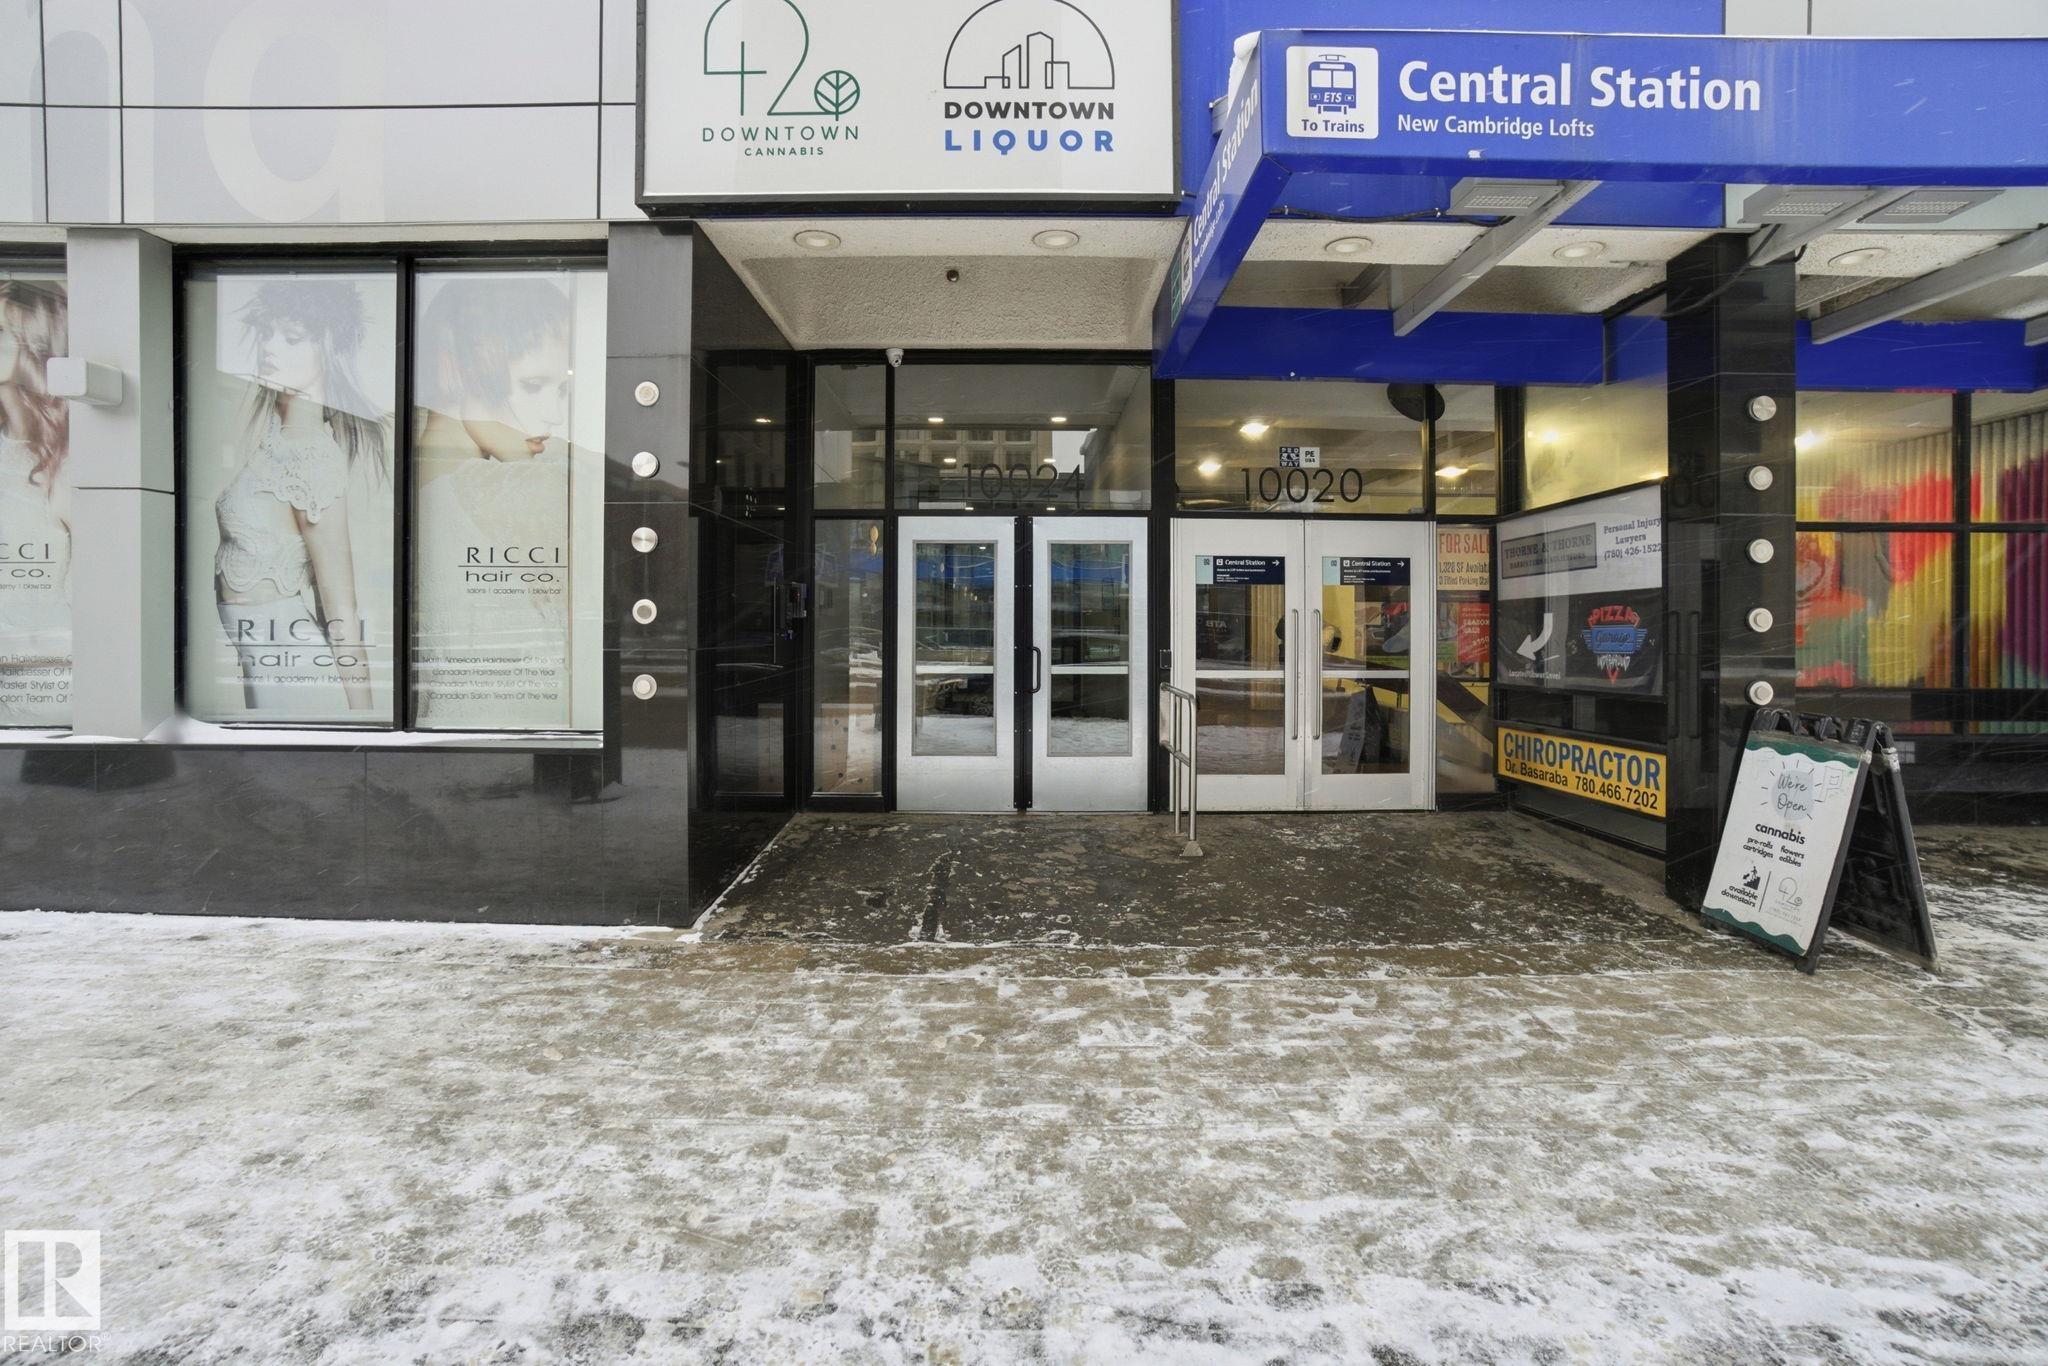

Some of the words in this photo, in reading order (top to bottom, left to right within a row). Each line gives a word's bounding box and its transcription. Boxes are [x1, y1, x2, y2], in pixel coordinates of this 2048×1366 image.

[1398, 59, 1571, 106] Central
[1590, 64, 1761, 112] Station
[1323, 91, 1343, 103] ETS
[943, 101, 1115, 120] DOWNTOWN
[702, 125, 860, 143] DOWNTOWN
[1301, 118, 1319, 132] To
[1322, 119, 1365, 133] Trains
[1397, 114, 1440, 133] New
[1444, 115, 1543, 140] Cambridge
[1549, 117, 1595, 138] Lofts
[743, 146, 825, 157] CANNABIS
[944, 128, 1115, 156] LIQUOR
[1192, 160, 1221, 247] Central
[1222, 78, 1259, 183] Station
[961, 462, 1086, 500] 10024
[1240, 467, 1364, 504] 10020
[1603, 520, 1636, 535] Personal
[1636, 517, 1662, 531] Injury
[1439, 533, 1461, 554] FOR
[1504, 543, 1541, 560] THORNE
[1551, 534, 1592, 550] THORNE
[1615, 533, 1647, 545] Lawyers
[466, 546, 560, 564] RICCI
[1603, 548, 1623, 561] (780)
[11, 568, 51, 578] co.
[465, 570, 513, 582] hair
[519, 573, 560, 583] co.
[1592, 604, 1636, 623] PIZZA
[237, 618, 366, 642] RICCI
[236, 651, 302, 668] hair
[312, 654, 368, 668] co.
[273, 675, 319, 686] academy
[25, 693, 54, 704] Team
[1503, 732, 1661, 791] CHIROPRACTOR
[1504, 758, 1518, 775] Dr.
[1520, 762, 1569, 787] Basaraba
[1575, 775, 1658, 810] 780.466.7202
[1777, 792, 1808, 818] Open
[1755, 823, 1806, 845] cannabis
[1742, 843, 1774, 859] cartridges
[1778, 855, 1802, 868] edibles
[1747, 837, 1774, 850] pre-rolls
[1780, 845, 1805, 859] flowers
[1720, 889, 1756, 908] downstairs
[1728, 885, 1759, 901] available
